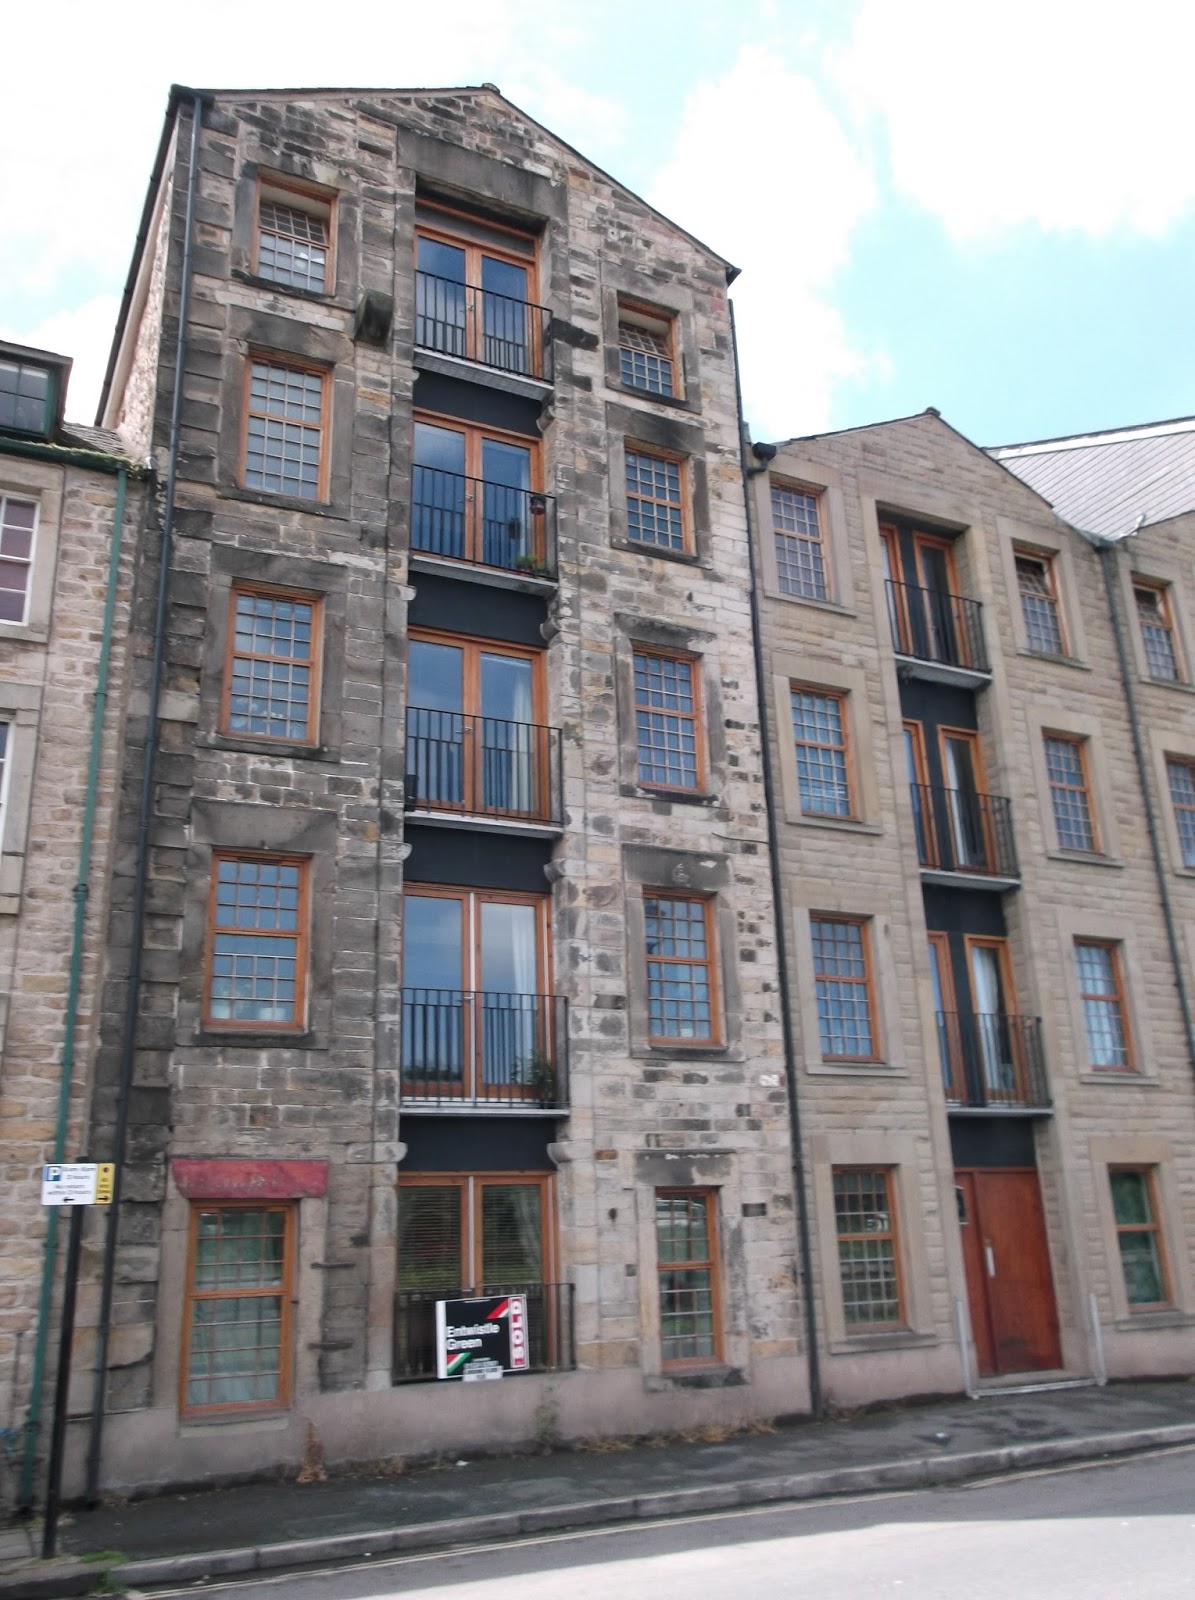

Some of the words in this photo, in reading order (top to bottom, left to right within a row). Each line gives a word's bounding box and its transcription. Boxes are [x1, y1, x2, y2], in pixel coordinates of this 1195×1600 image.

[48, 1166, 60, 1181] P
[446, 1322, 500, 1338] Entwistle
[510, 1301, 525, 1358] SOLD
[446, 1338, 483, 1350] Green
